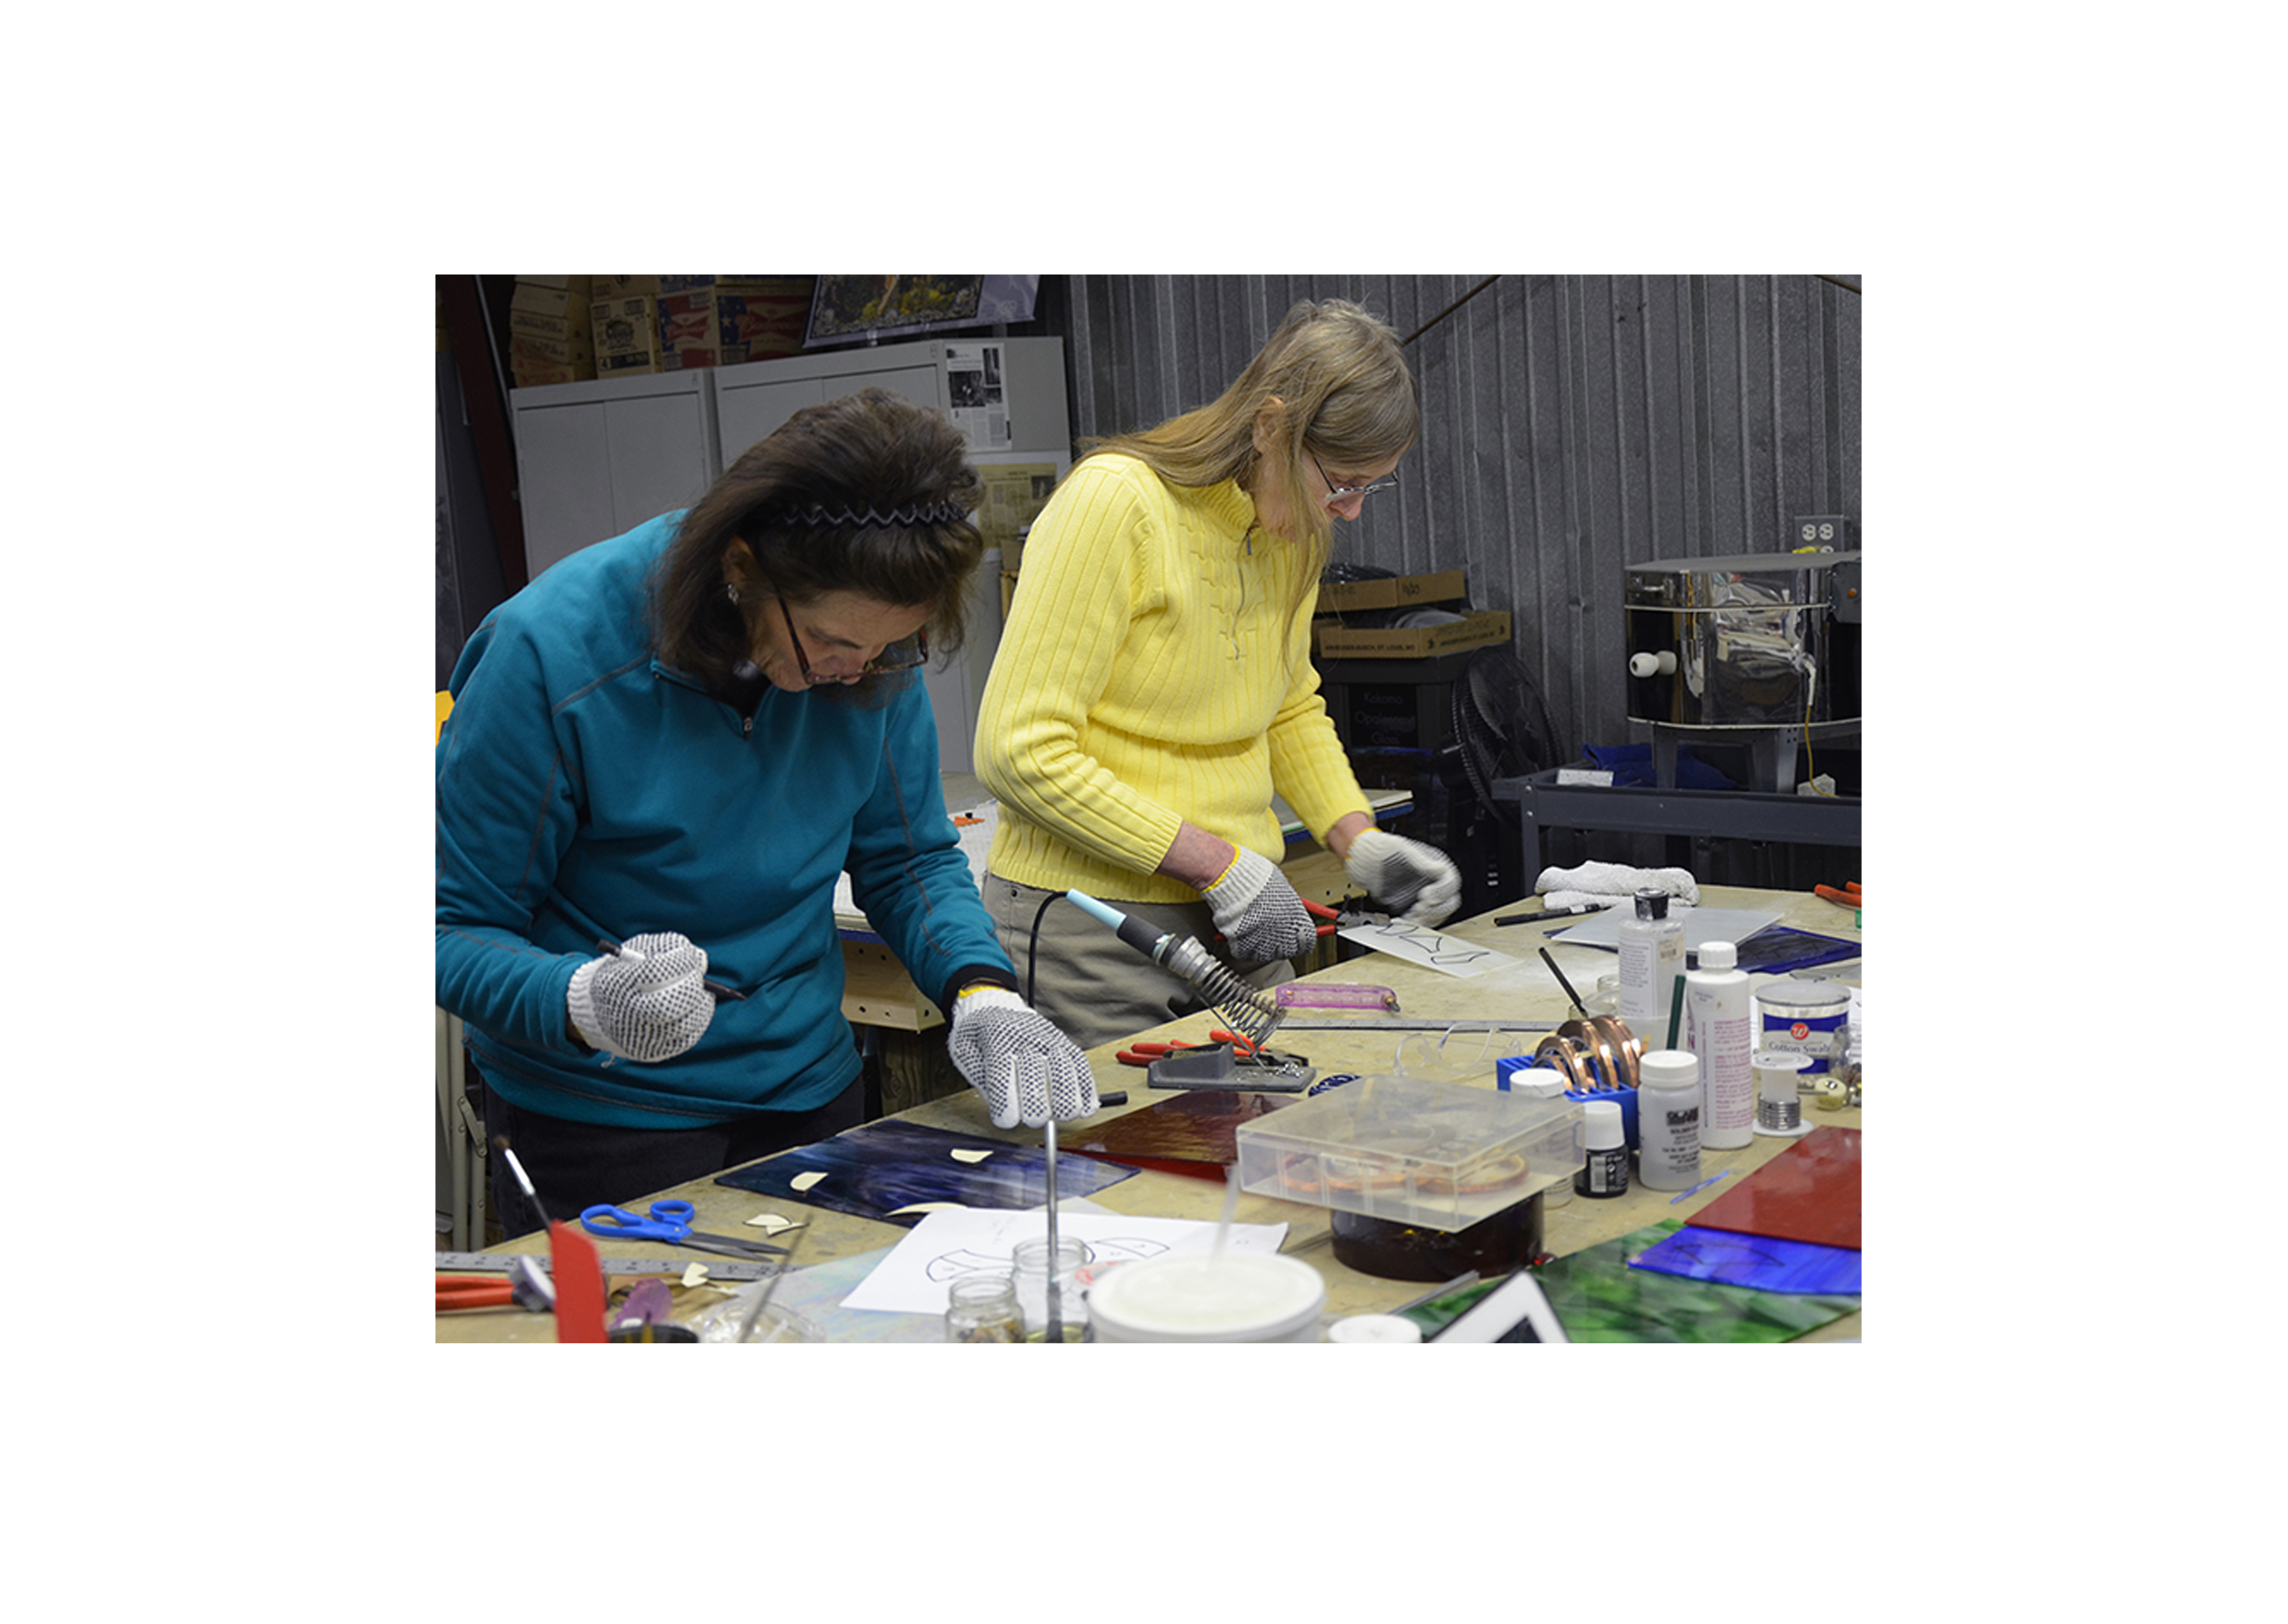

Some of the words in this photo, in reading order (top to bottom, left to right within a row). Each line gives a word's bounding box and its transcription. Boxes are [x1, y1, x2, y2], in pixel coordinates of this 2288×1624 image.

[1364, 692, 1403, 706] Kokomo
[1769, 1041, 1801, 1052] Cotton
[1803, 1043, 1831, 1054] Swab
